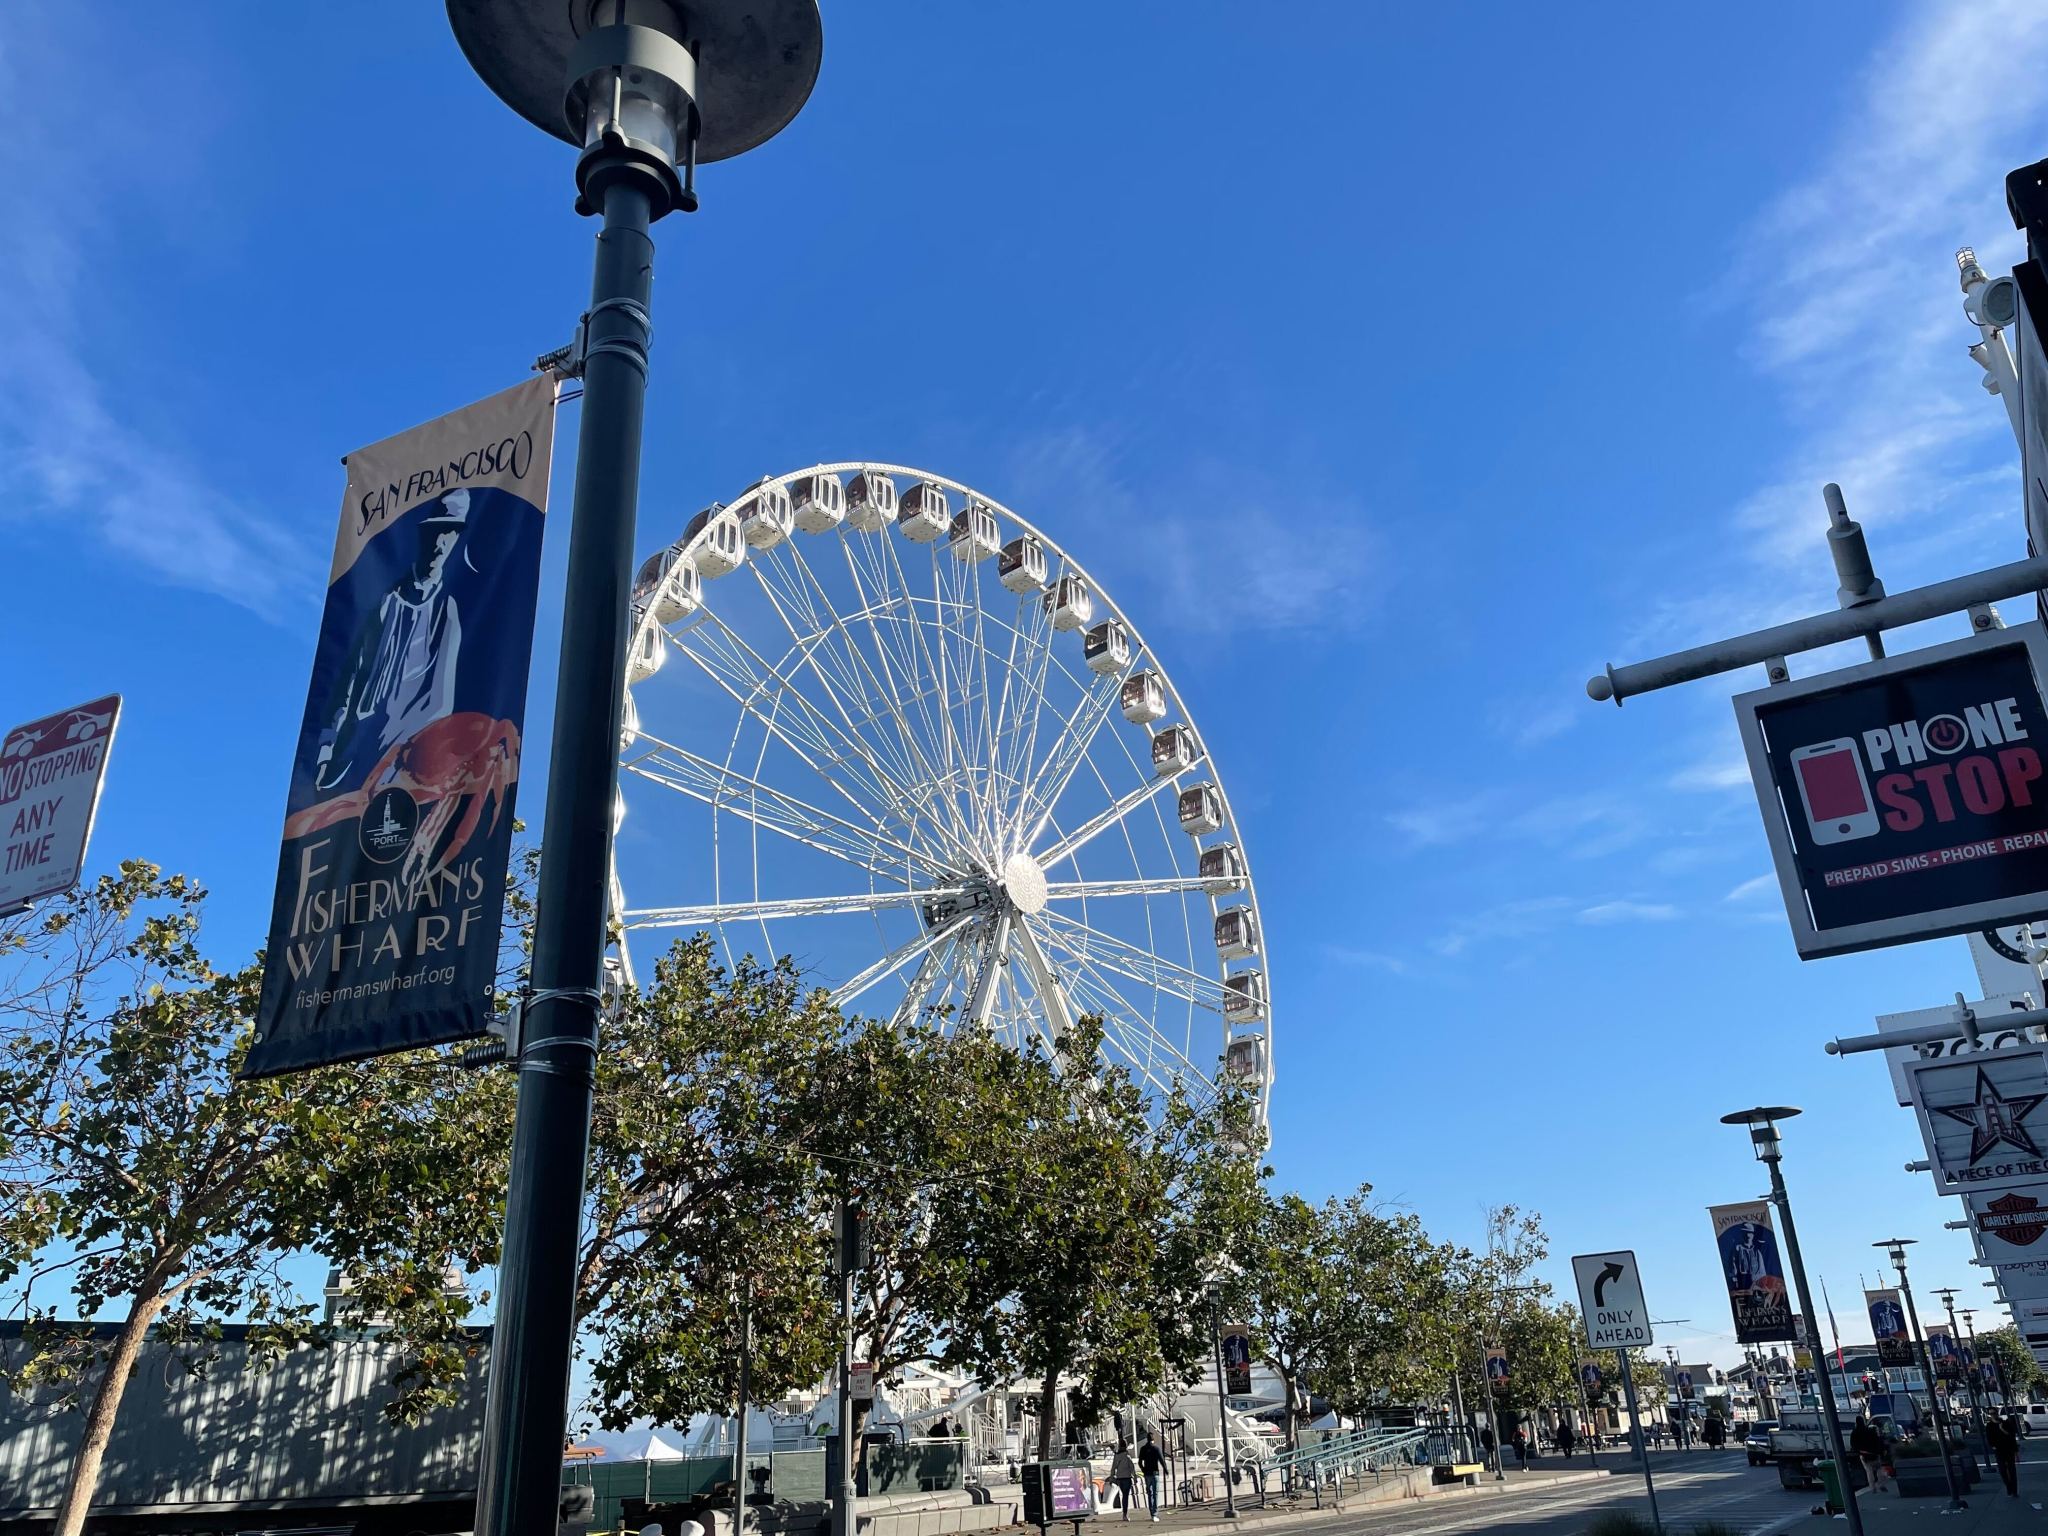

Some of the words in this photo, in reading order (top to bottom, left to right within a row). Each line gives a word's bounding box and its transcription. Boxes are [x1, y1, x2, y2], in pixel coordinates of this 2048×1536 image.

[357, 480, 402, 536] SAN
[404, 430, 533, 502] FRANCISCO
[1862, 697, 2028, 772] PHONE
[25, 743, 100, 790] STOPPING
[1876, 747, 2043, 832] STOP
[10, 796, 64, 838] ANY
[6, 833, 55, 875] TIME
[373, 834, 399, 846] PORT
[1824, 863, 1888, 886] PREPAID
[1891, 855, 1929, 873] SIMS
[1941, 842, 1998, 862] PHONE
[290, 838, 484, 938] FISHERMAN'S
[286, 905, 482, 982] WHARF
[295, 965, 455, 1010] fishermanswharf.org
[1958, 1166, 1992, 1179] PIECE
[1995, 1164, 2013, 1175] OF
[2016, 1161, 2041, 1173] THE
[1595, 1326, 1644, 1343] AHEAD
[1597, 1309, 1633, 1325] ONLY
